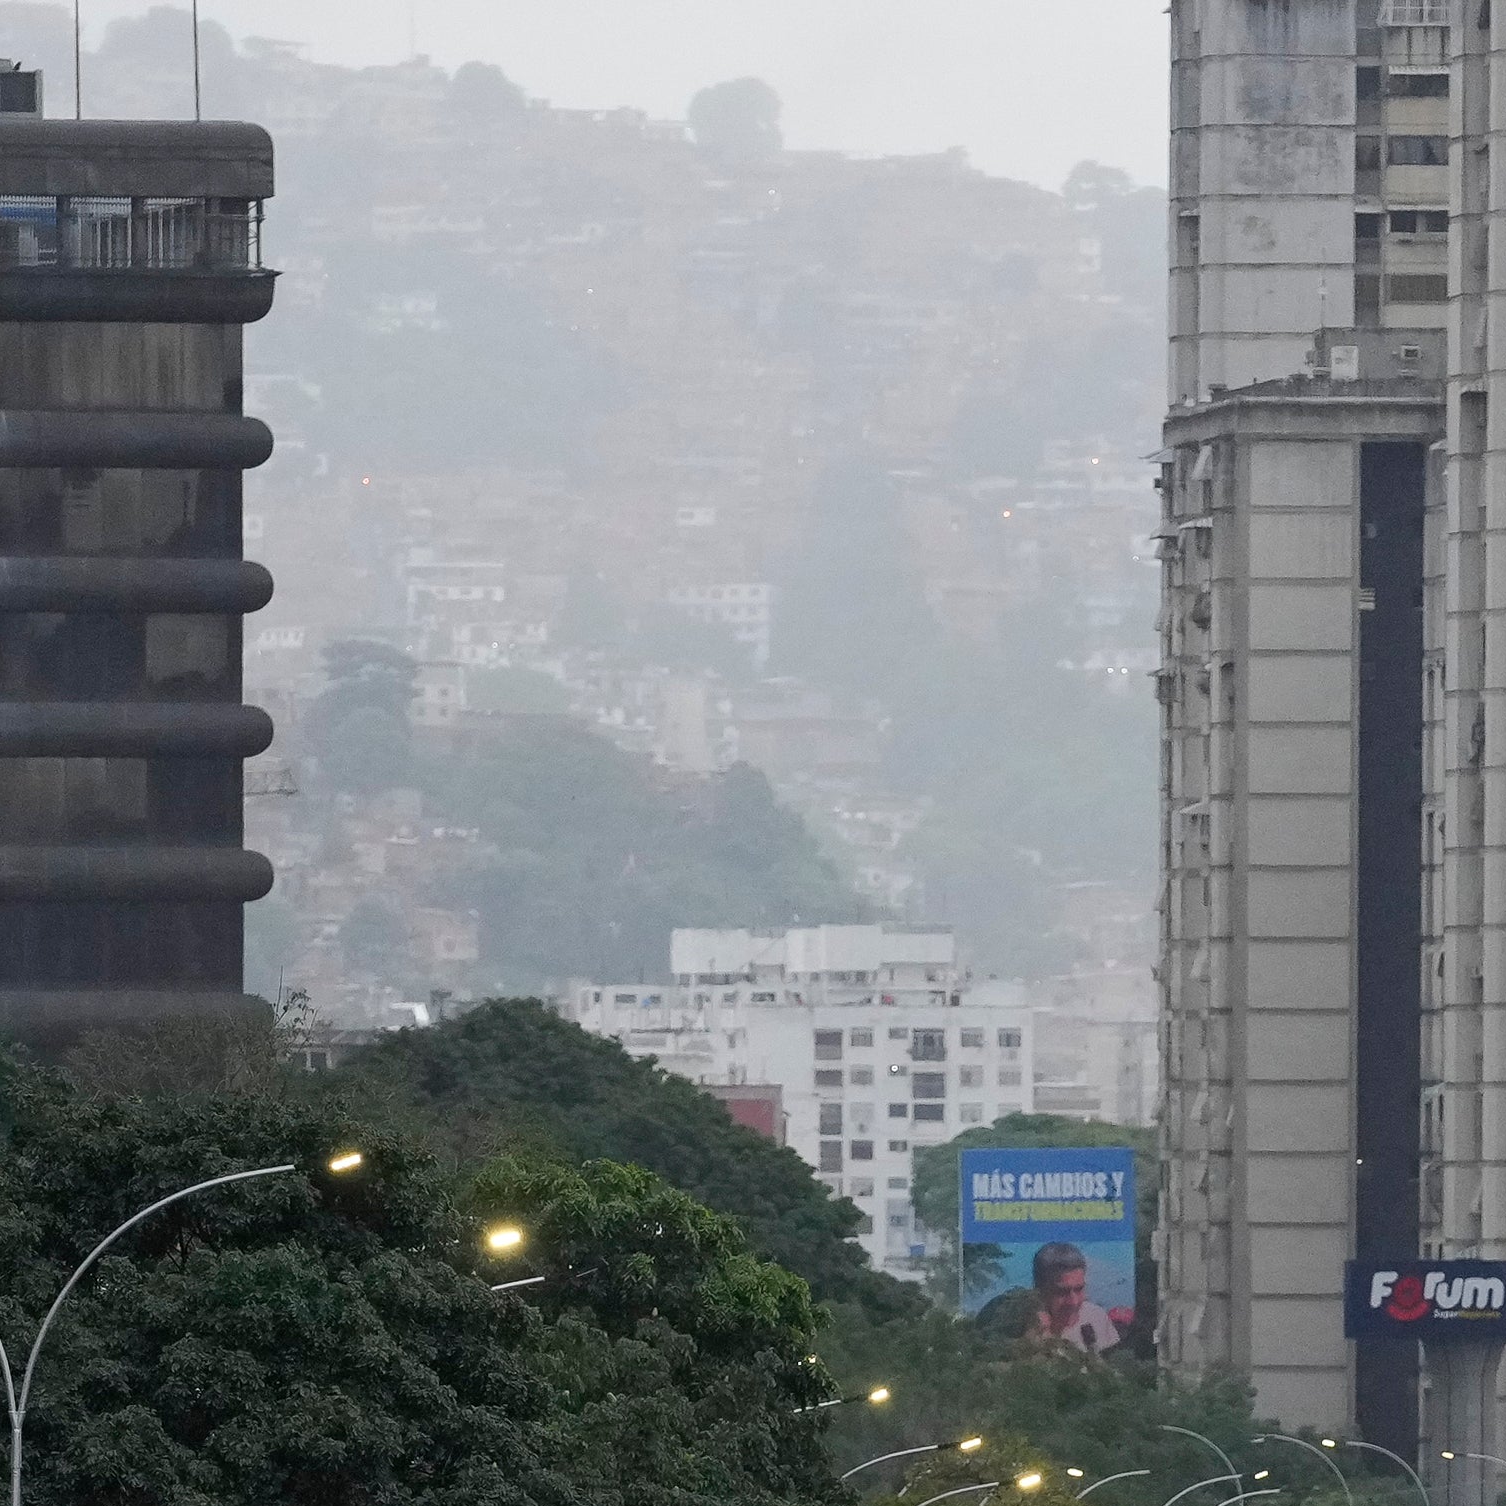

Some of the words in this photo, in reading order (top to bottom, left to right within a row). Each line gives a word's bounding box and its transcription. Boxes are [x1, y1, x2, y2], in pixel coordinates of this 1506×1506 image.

[973, 1168, 1015, 1199] MÁS
[1019, 1171, 1108, 1199] CAMBIOS
[1111, 1171, 1125, 1198] Y
